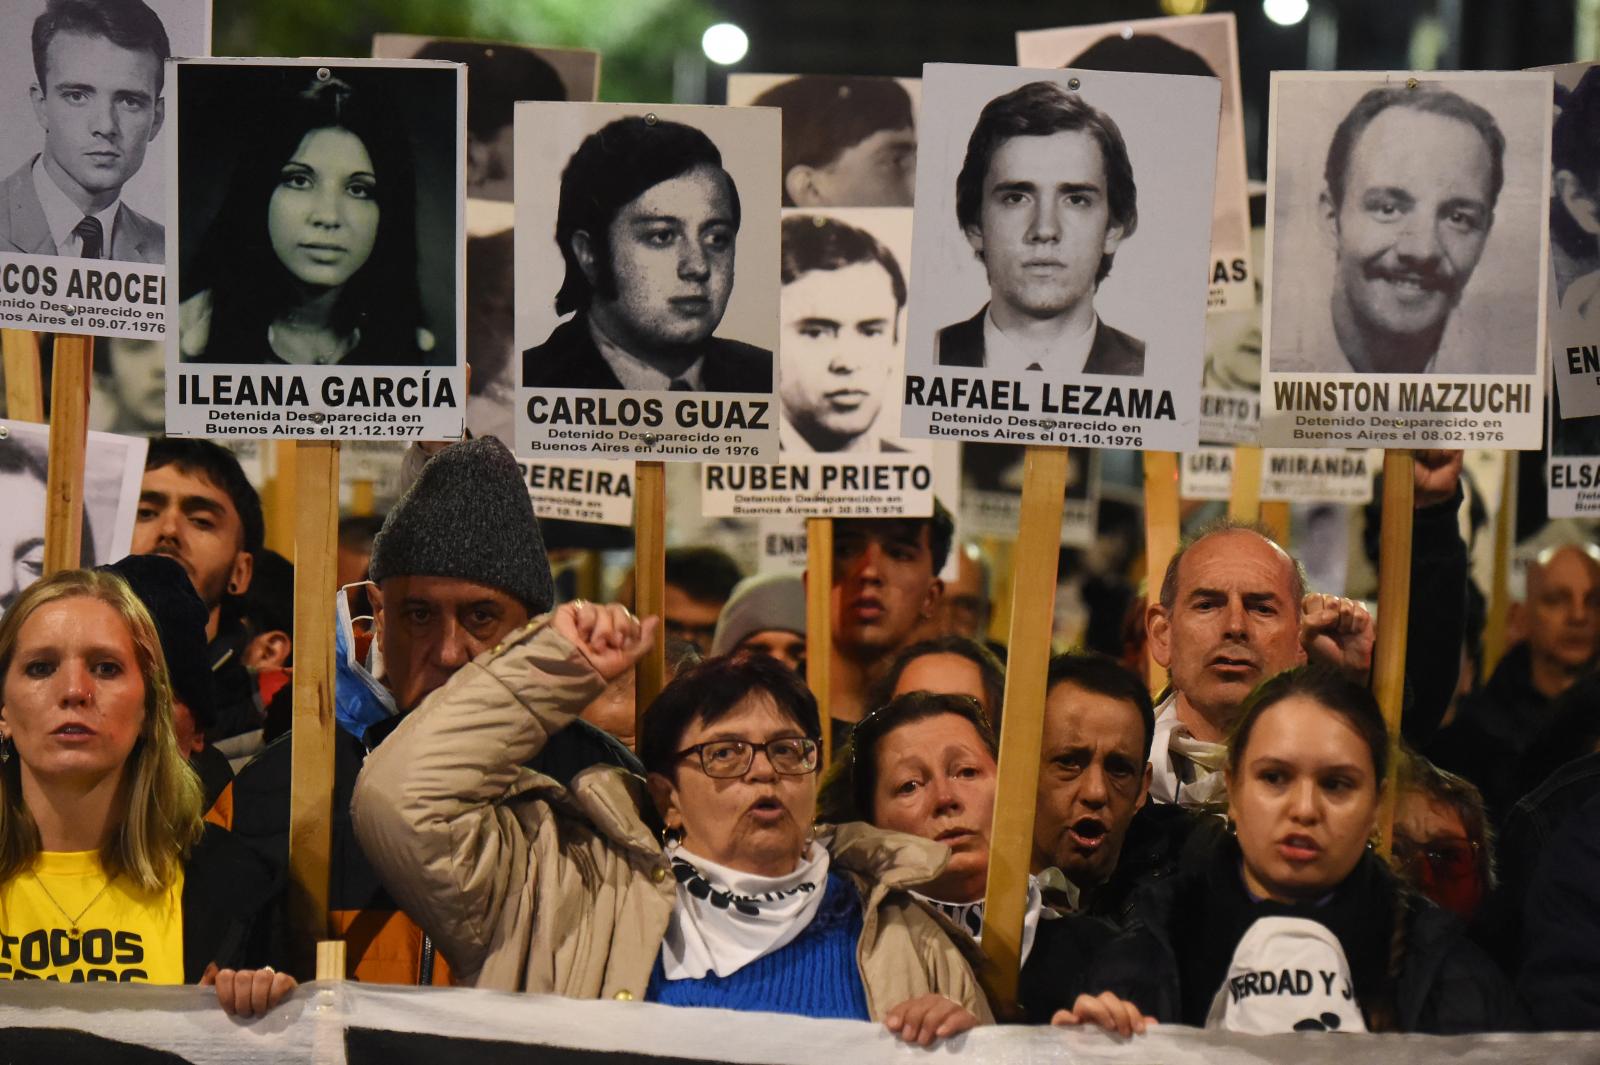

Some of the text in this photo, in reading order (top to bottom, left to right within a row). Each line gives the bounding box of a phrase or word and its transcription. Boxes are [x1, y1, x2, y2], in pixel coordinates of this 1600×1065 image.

[0, 263, 58, 297] COS
[0, 298, 35, 309] nido
[147, 310, 164, 321] en
[27, 313, 66, 326] Aires
[70, 317, 83, 327] el
[88, 318, 166, 334] 09.07.1976
[178, 370, 457, 408] ILEANA GARCÍA
[904, 375, 1177, 421] RAFAEL LEZAMA
[1274, 381, 1532, 414] WINSTON MAZZUCHI
[208, 410, 281, 422] Detenida
[402, 413, 421, 423] en
[526, 395, 769, 430] CARLOS GUAZ
[931, 411, 1003, 425] Detenido
[1121, 423, 1142, 434] en
[1295, 416, 1366, 427] Detenido
[1483, 419, 1502, 428] en
[205, 424, 425, 436] Buenos Aires el 21.12.1977
[548, 428, 742, 443] Detenido Desparecido en
[929, 424, 1143, 448] Buenos Aires el 01.10.1976
[1293, 429, 1504, 442] Buenos Aires el 08.02.1976
[531, 440, 760, 457] Buenos Aires en Junio de 1976
[1270, 455, 1368, 477] MIRANDA
[706, 465, 931, 491] RUBEN PRIETO
[1319, 970, 1337, 997] Y
